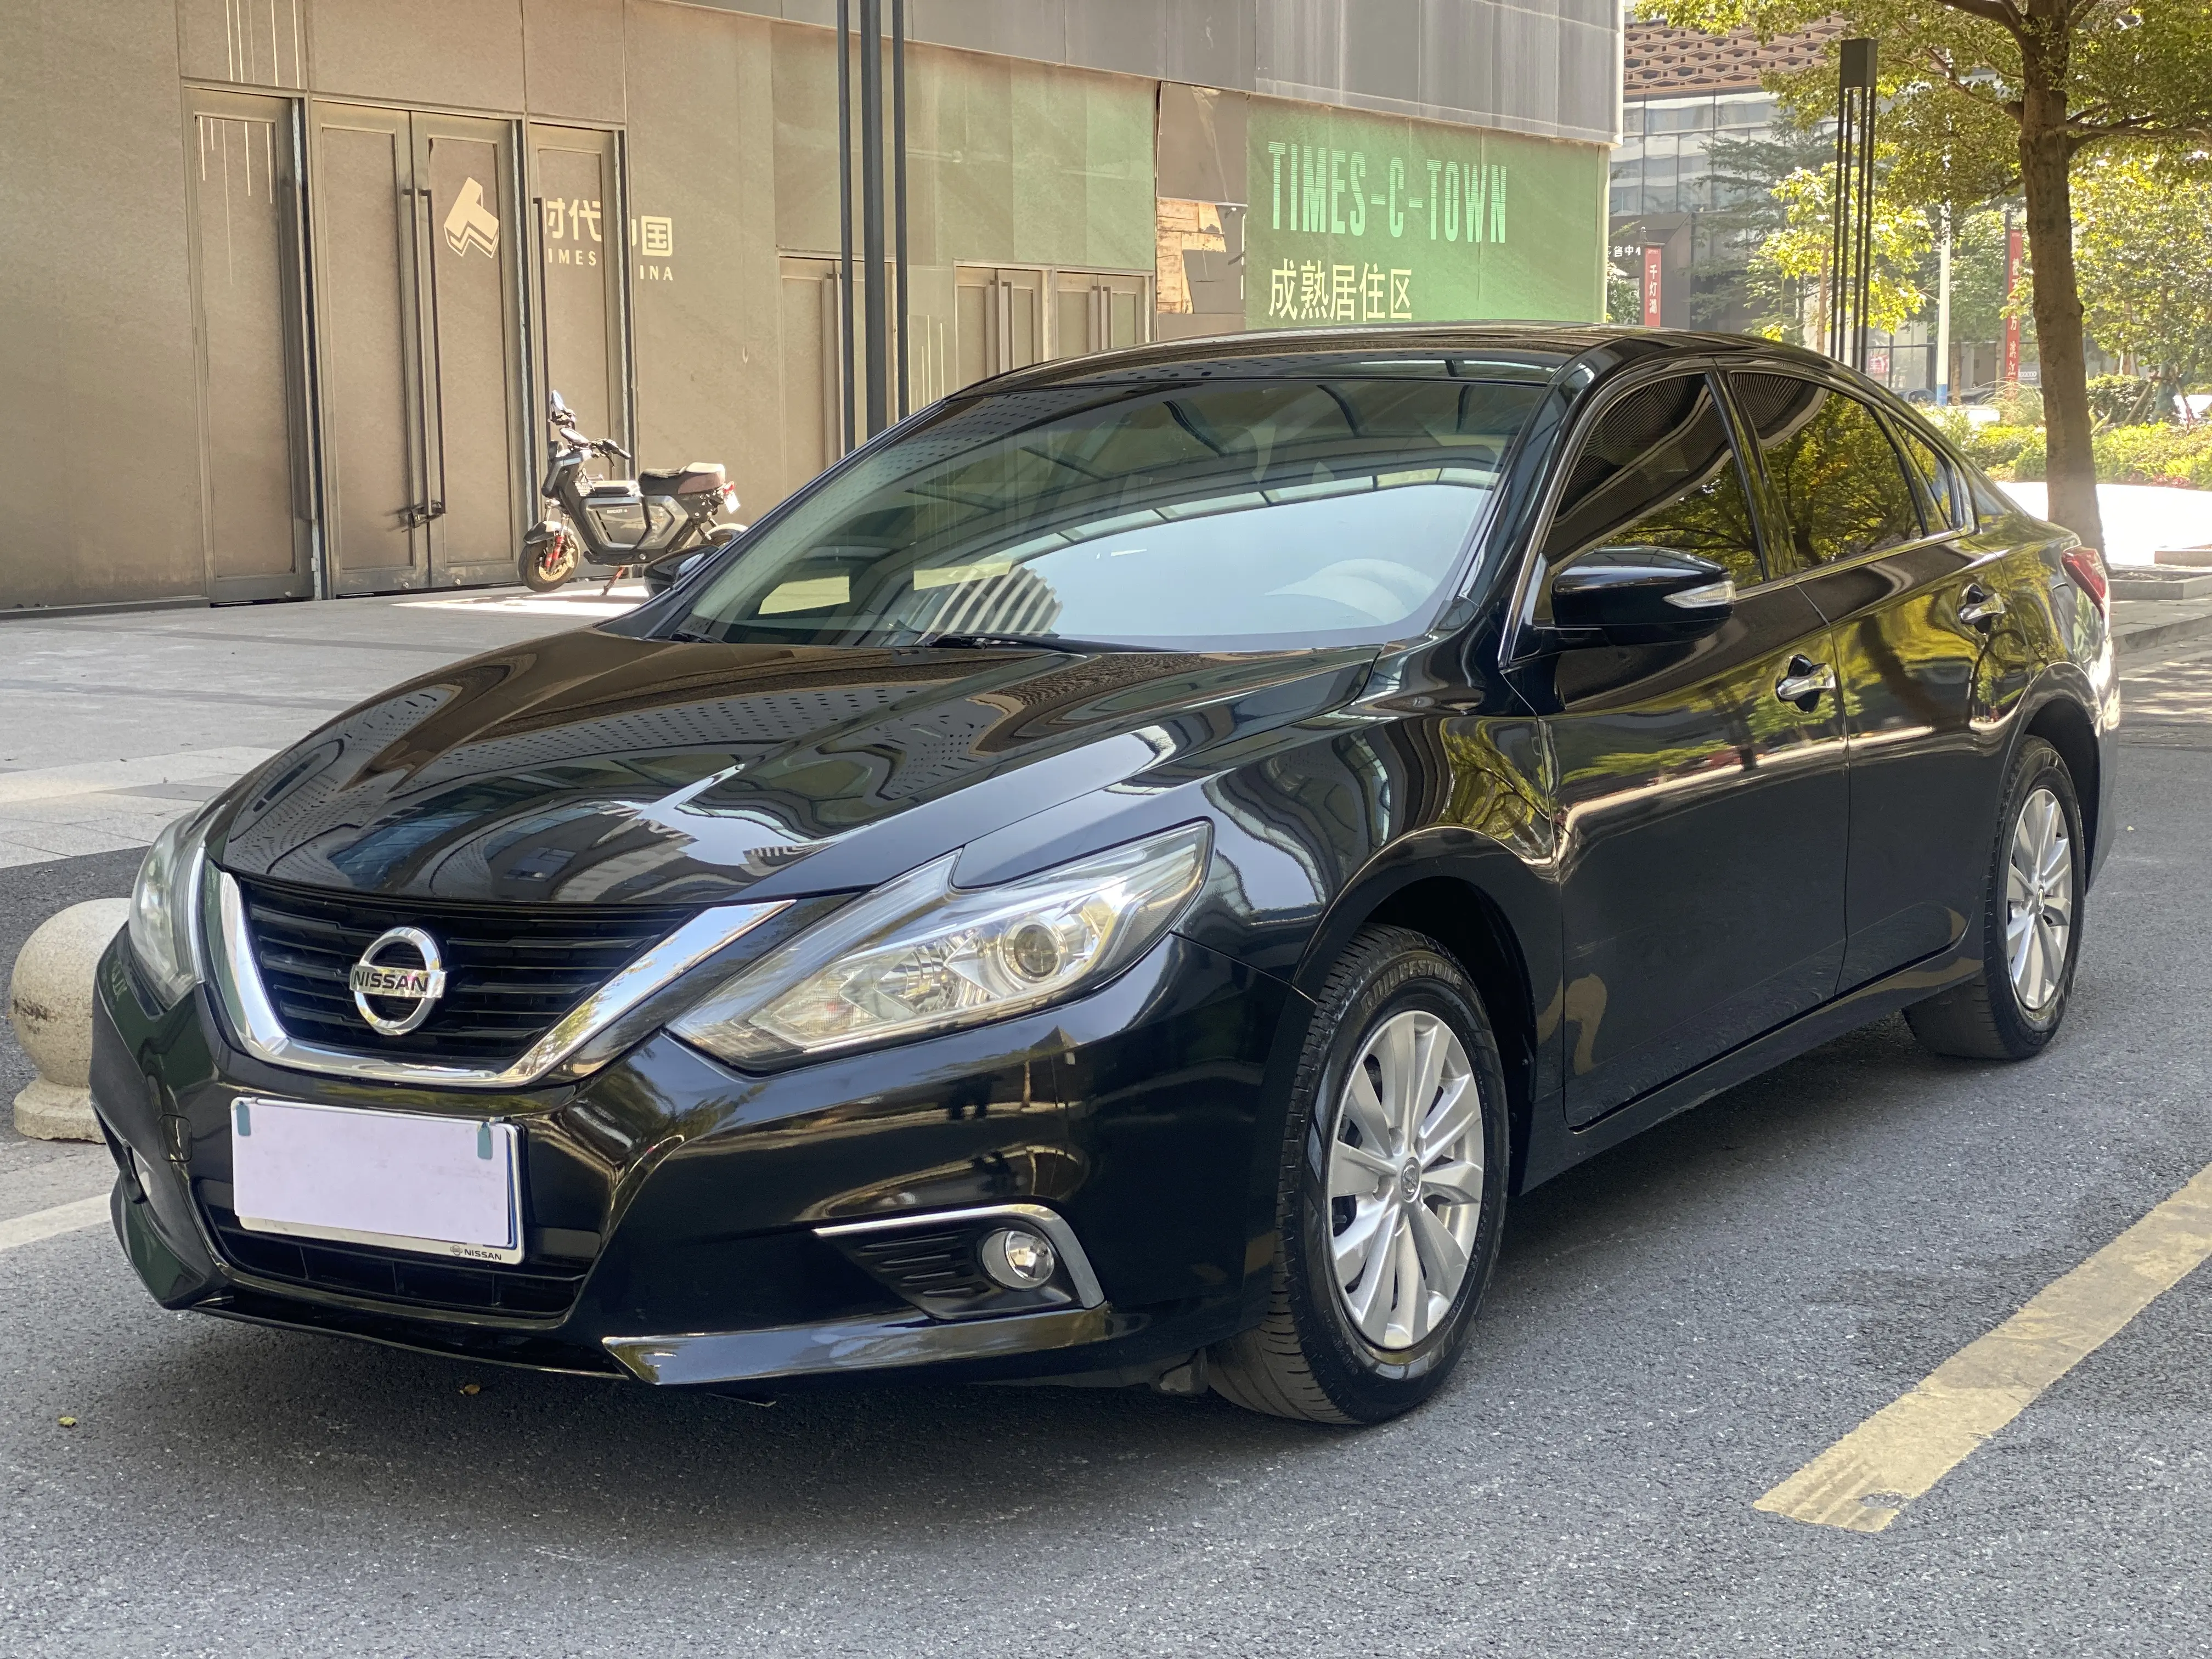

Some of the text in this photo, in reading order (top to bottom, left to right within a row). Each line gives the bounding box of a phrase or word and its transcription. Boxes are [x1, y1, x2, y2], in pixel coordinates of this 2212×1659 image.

[1268, 141, 1507, 244] TIMES-C-TOWN
[548, 248, 673, 281] IMES INA
[1268, 258, 1413, 321] 成熟居住区
[353, 970, 430, 992] NISSAN
[464, 1249, 502, 1261] NISSAN
